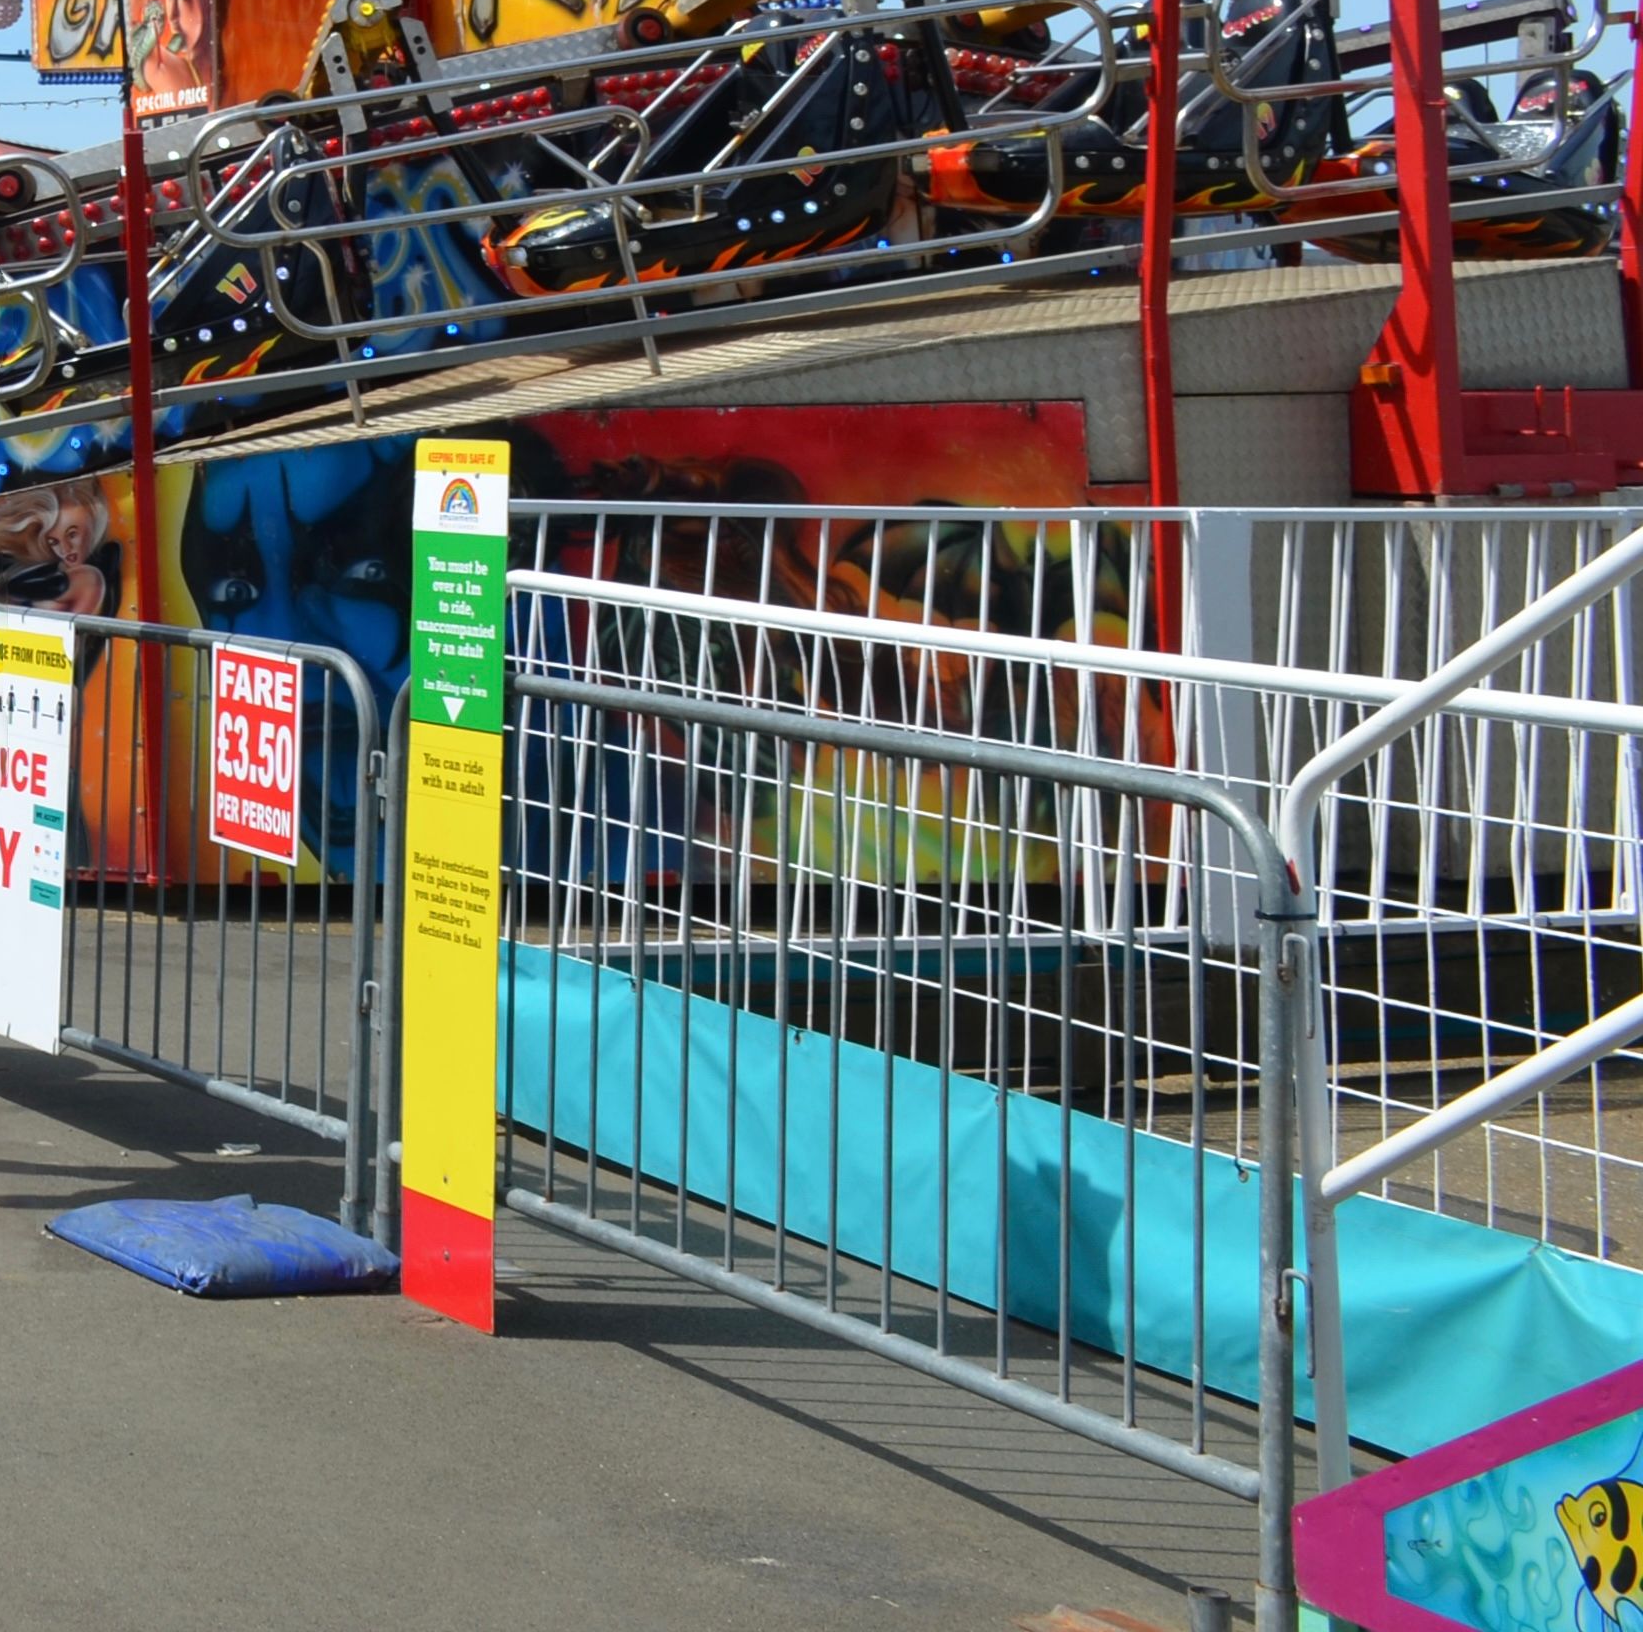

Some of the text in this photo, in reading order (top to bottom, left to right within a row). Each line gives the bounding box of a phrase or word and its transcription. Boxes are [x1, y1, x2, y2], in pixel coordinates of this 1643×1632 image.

[136, 85, 208, 113] SPECIAL PRICE
[215, 262, 258, 304] 17
[428, 452, 495, 464] KEEPING YOU SAFE AT
[427, 556, 488, 575] You must be
[433, 580, 482, 596] over a 1m
[439, 600, 449, 613] to
[416, 620, 495, 640] unaccompanied
[11, 645, 66, 669] FROM OTHERS
[428, 638, 484, 659] by an adult
[219, 659, 293, 713] FARE
[436, 680, 460, 696] Riding
[461, 686, 470, 695] on
[472, 687, 487, 698] own
[217, 711, 293, 793] £3.50
[423, 753, 483, 776] You can ride
[421, 774, 485, 796] with an adult
[216, 792, 291, 839] PER PERSON
[414, 851, 489, 879] Height restrictions
[412, 872, 490, 901] are in place to keep
[414, 889, 486, 914] you safe our team
[429, 911, 470, 928] member's
[418, 922, 481, 949] decision is final
